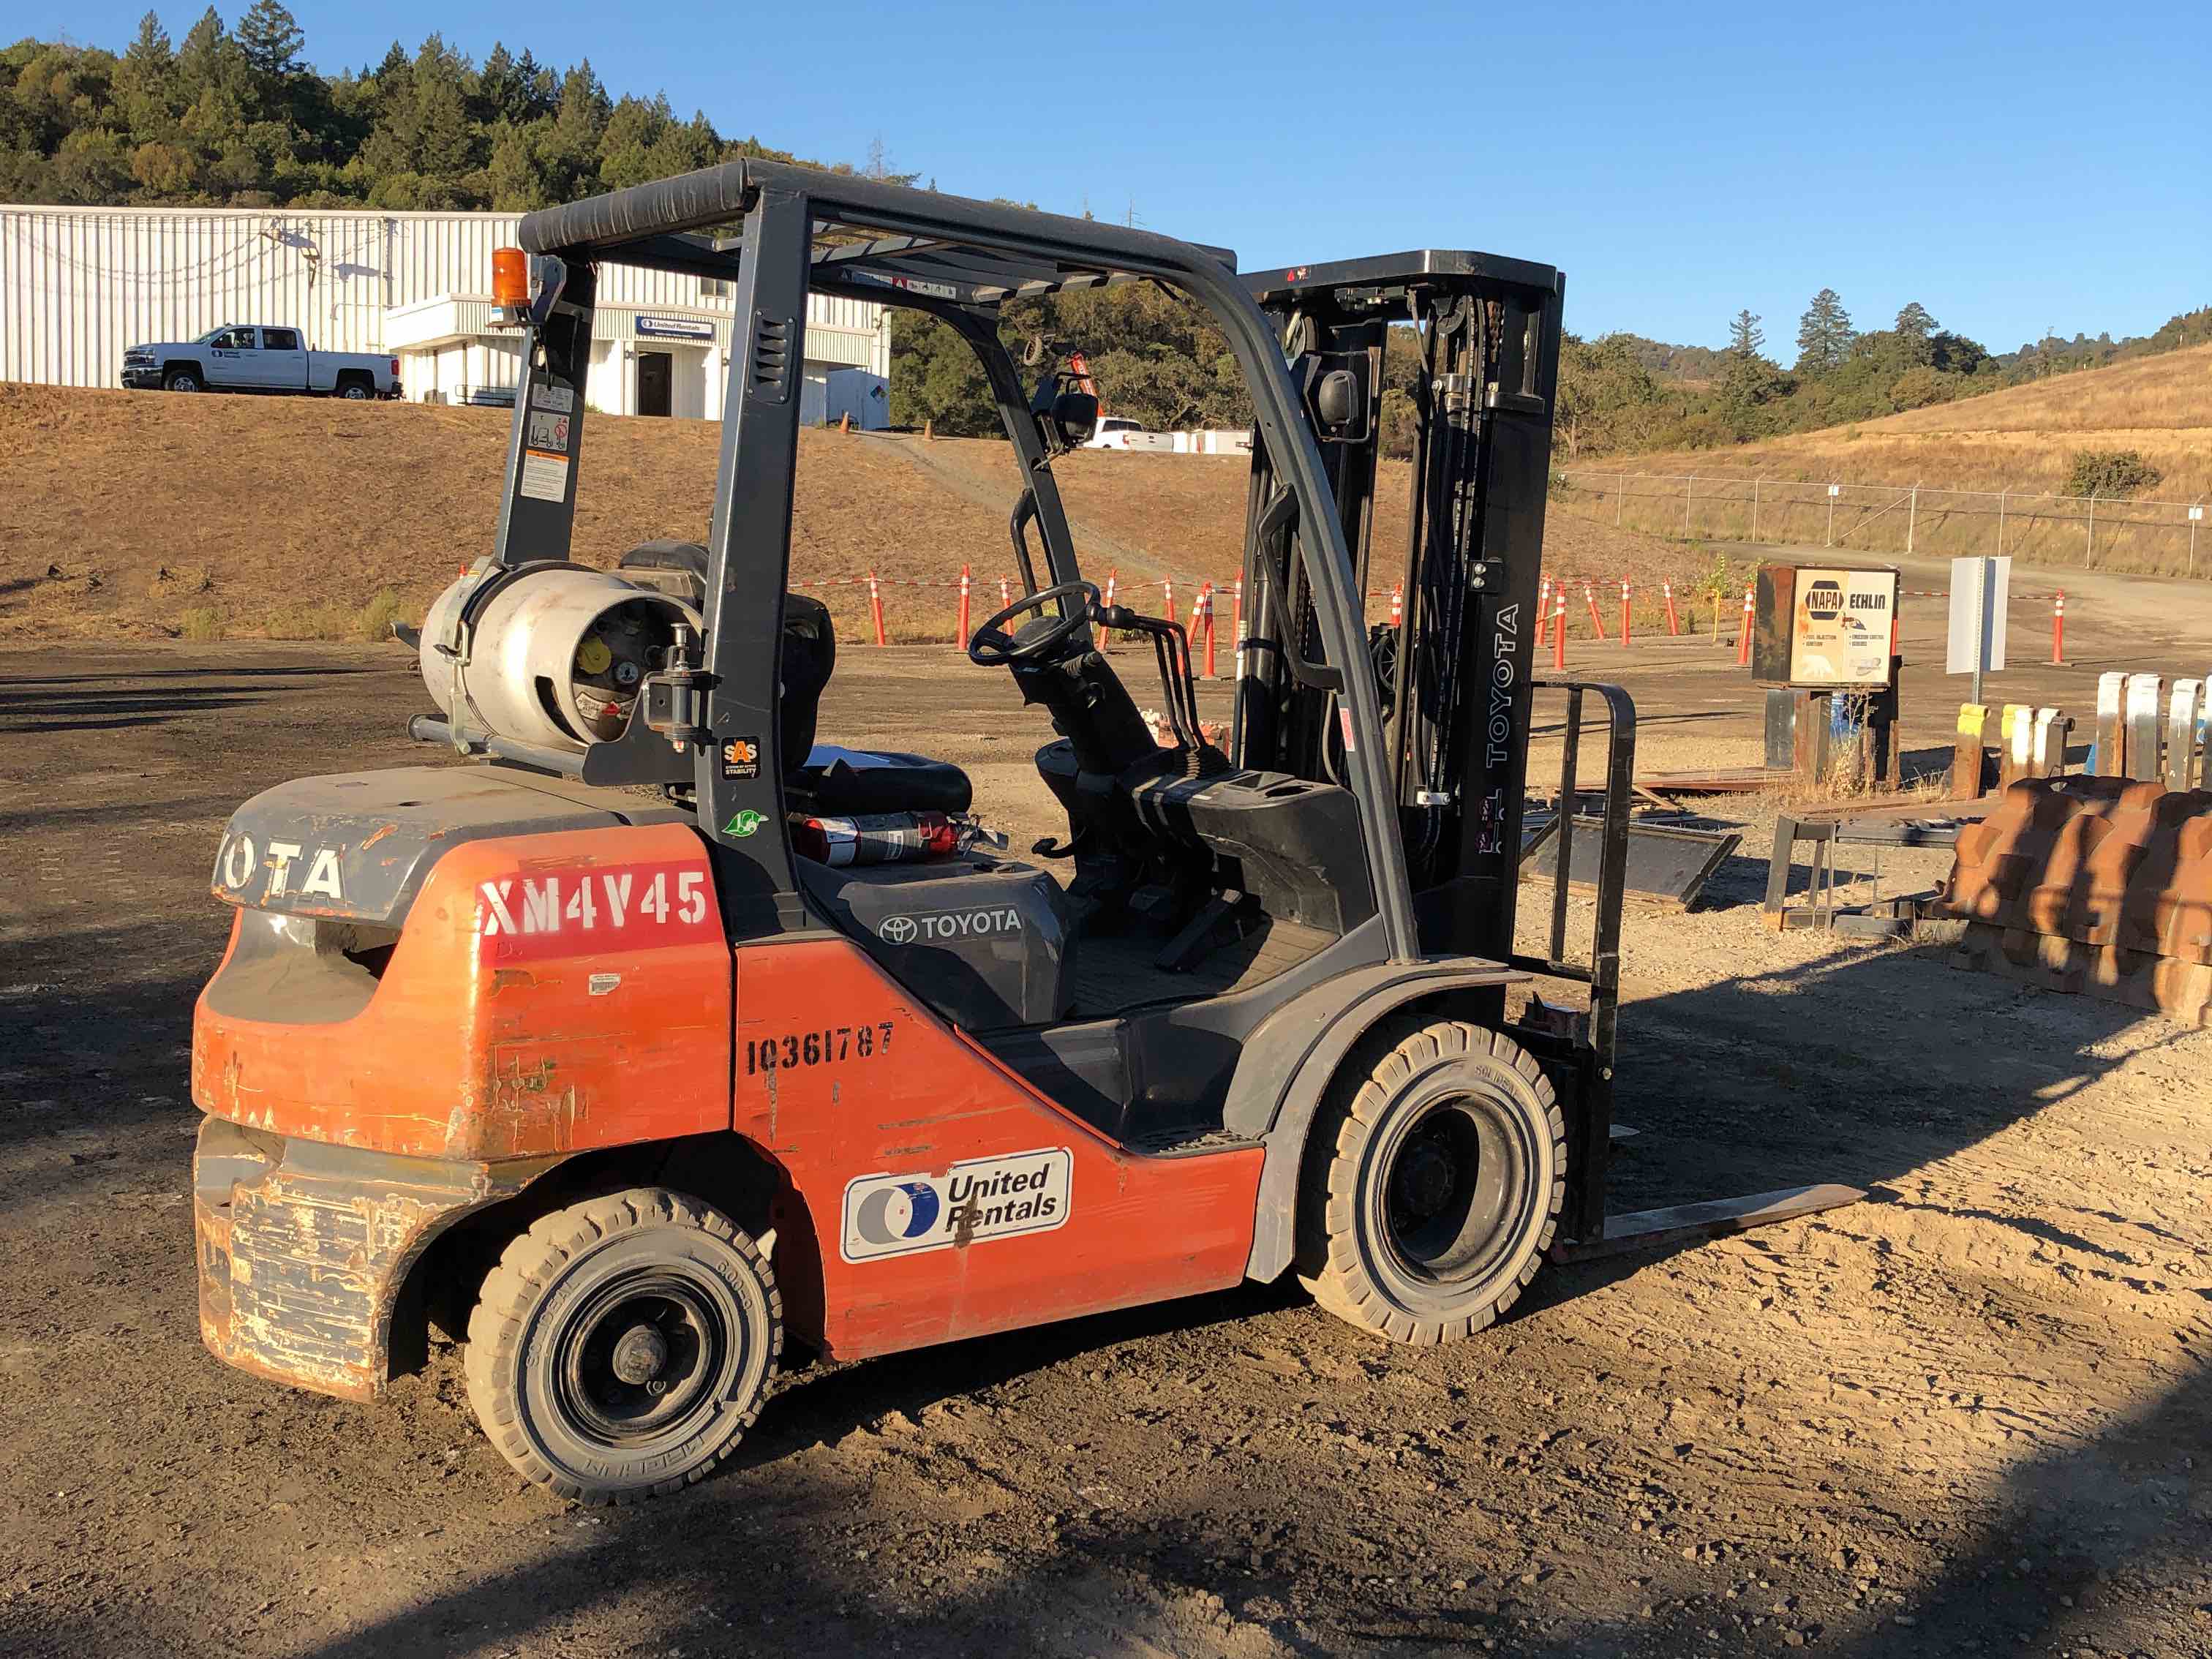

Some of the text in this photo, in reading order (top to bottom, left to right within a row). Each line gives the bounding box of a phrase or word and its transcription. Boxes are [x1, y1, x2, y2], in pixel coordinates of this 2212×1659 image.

[1811, 591, 1837, 609] NAPA
[1849, 593, 1886, 609] ECHLIN
[1486, 603, 1519, 768] TOYOTA
[724, 740, 757, 764] SAS
[220, 832, 342, 899] OTA
[480, 871, 707, 936] XM4V45
[922, 908, 1022, 939] TOYOTA
[747, 1022, 894, 1075] 10361787
[948, 1163, 1050, 1203] United
[944, 1192, 1058, 1233] Rentals
